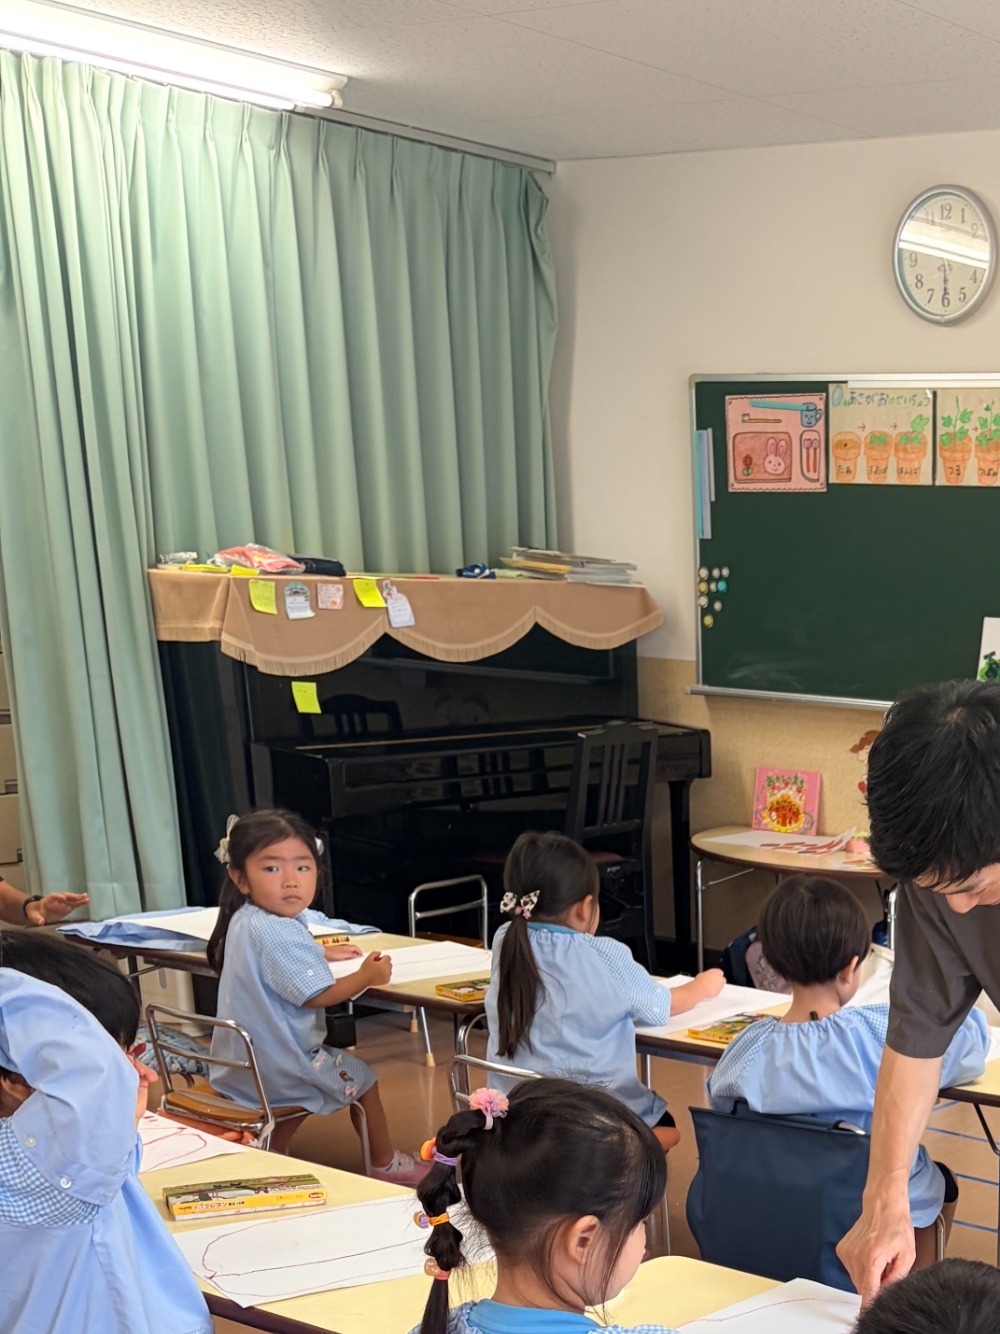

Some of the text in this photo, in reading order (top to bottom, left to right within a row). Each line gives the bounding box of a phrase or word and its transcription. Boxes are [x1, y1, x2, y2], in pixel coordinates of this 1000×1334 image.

[940, 203, 952, 220] 12
[961, 207, 966, 223] 1
[909, 252, 918, 268] 9
[915, 273, 924, 289] 8
[970, 268, 978, 284] 4
[927, 288, 935, 304] 7
[941, 292, 951, 308] 6
[959, 287, 966, 303] 5
